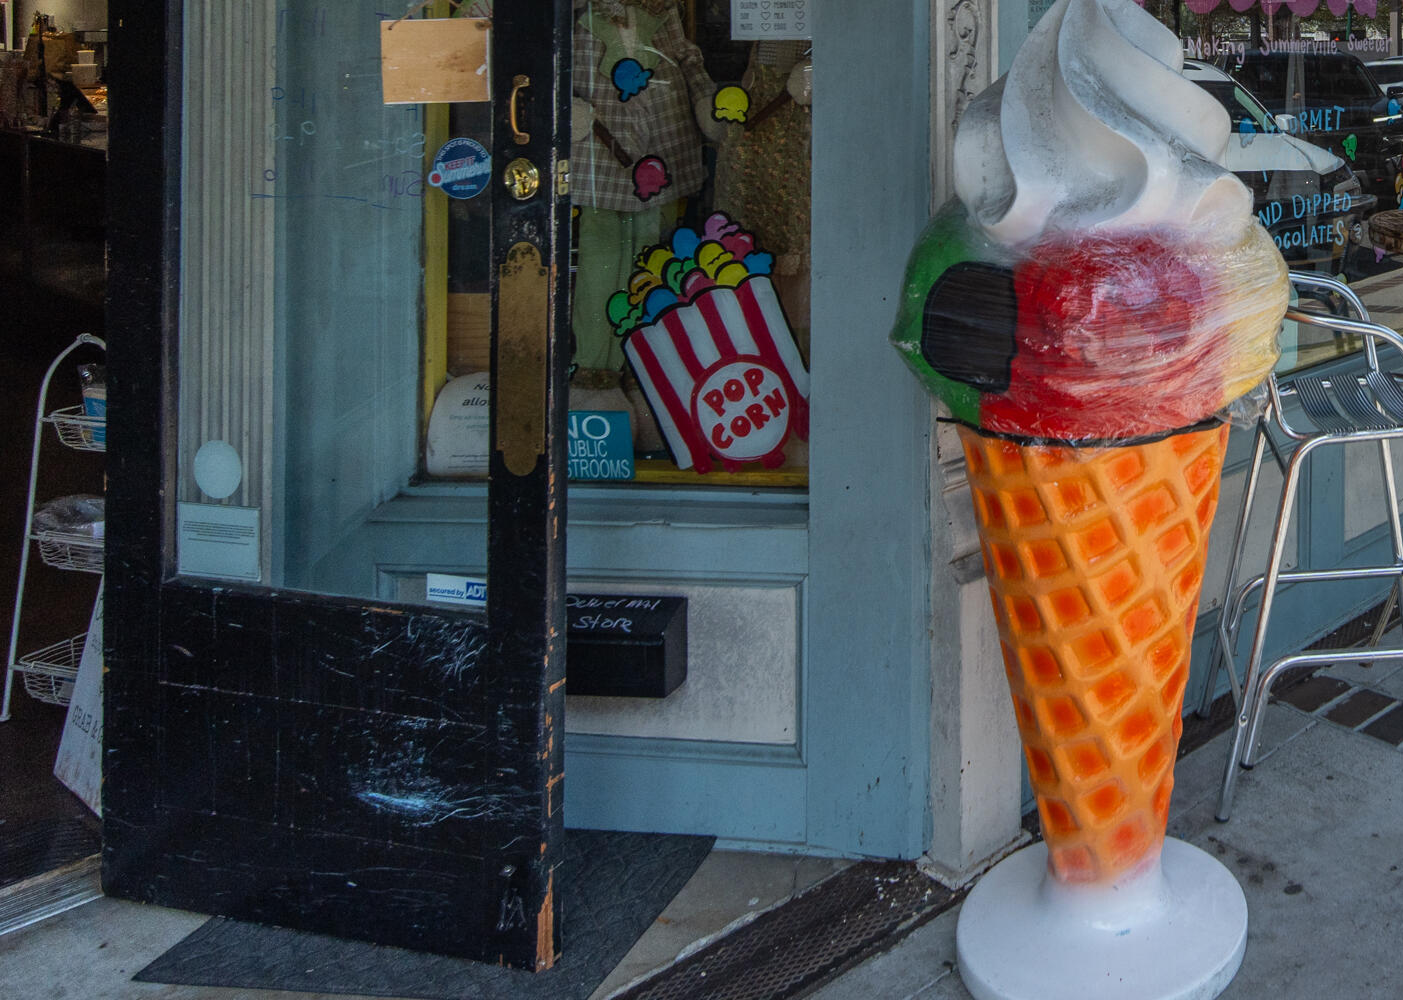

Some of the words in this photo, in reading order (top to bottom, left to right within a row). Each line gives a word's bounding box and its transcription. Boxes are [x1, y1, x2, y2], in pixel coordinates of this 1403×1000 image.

[1187, 35, 1245, 64] Making
[1259, 33, 1338, 56] Summerville
[1347, 33, 1392, 53] Sweeter
[444, 160, 465, 170] KEEP
[1258, 200, 1283, 227] ND
[1273, 220, 1345, 251] OCOLATES
[462, 397, 490, 407] allo
[702, 367, 765, 418] POP
[568, 414, 611, 440] NO
[711, 387, 787, 450] CORN
[568, 439, 608, 457] UBLIC
[568, 459, 631, 479] TROOMS
[429, 586, 455, 596] secured
[456, 587, 465, 597] by
[466, 583, 487, 598] ADT
